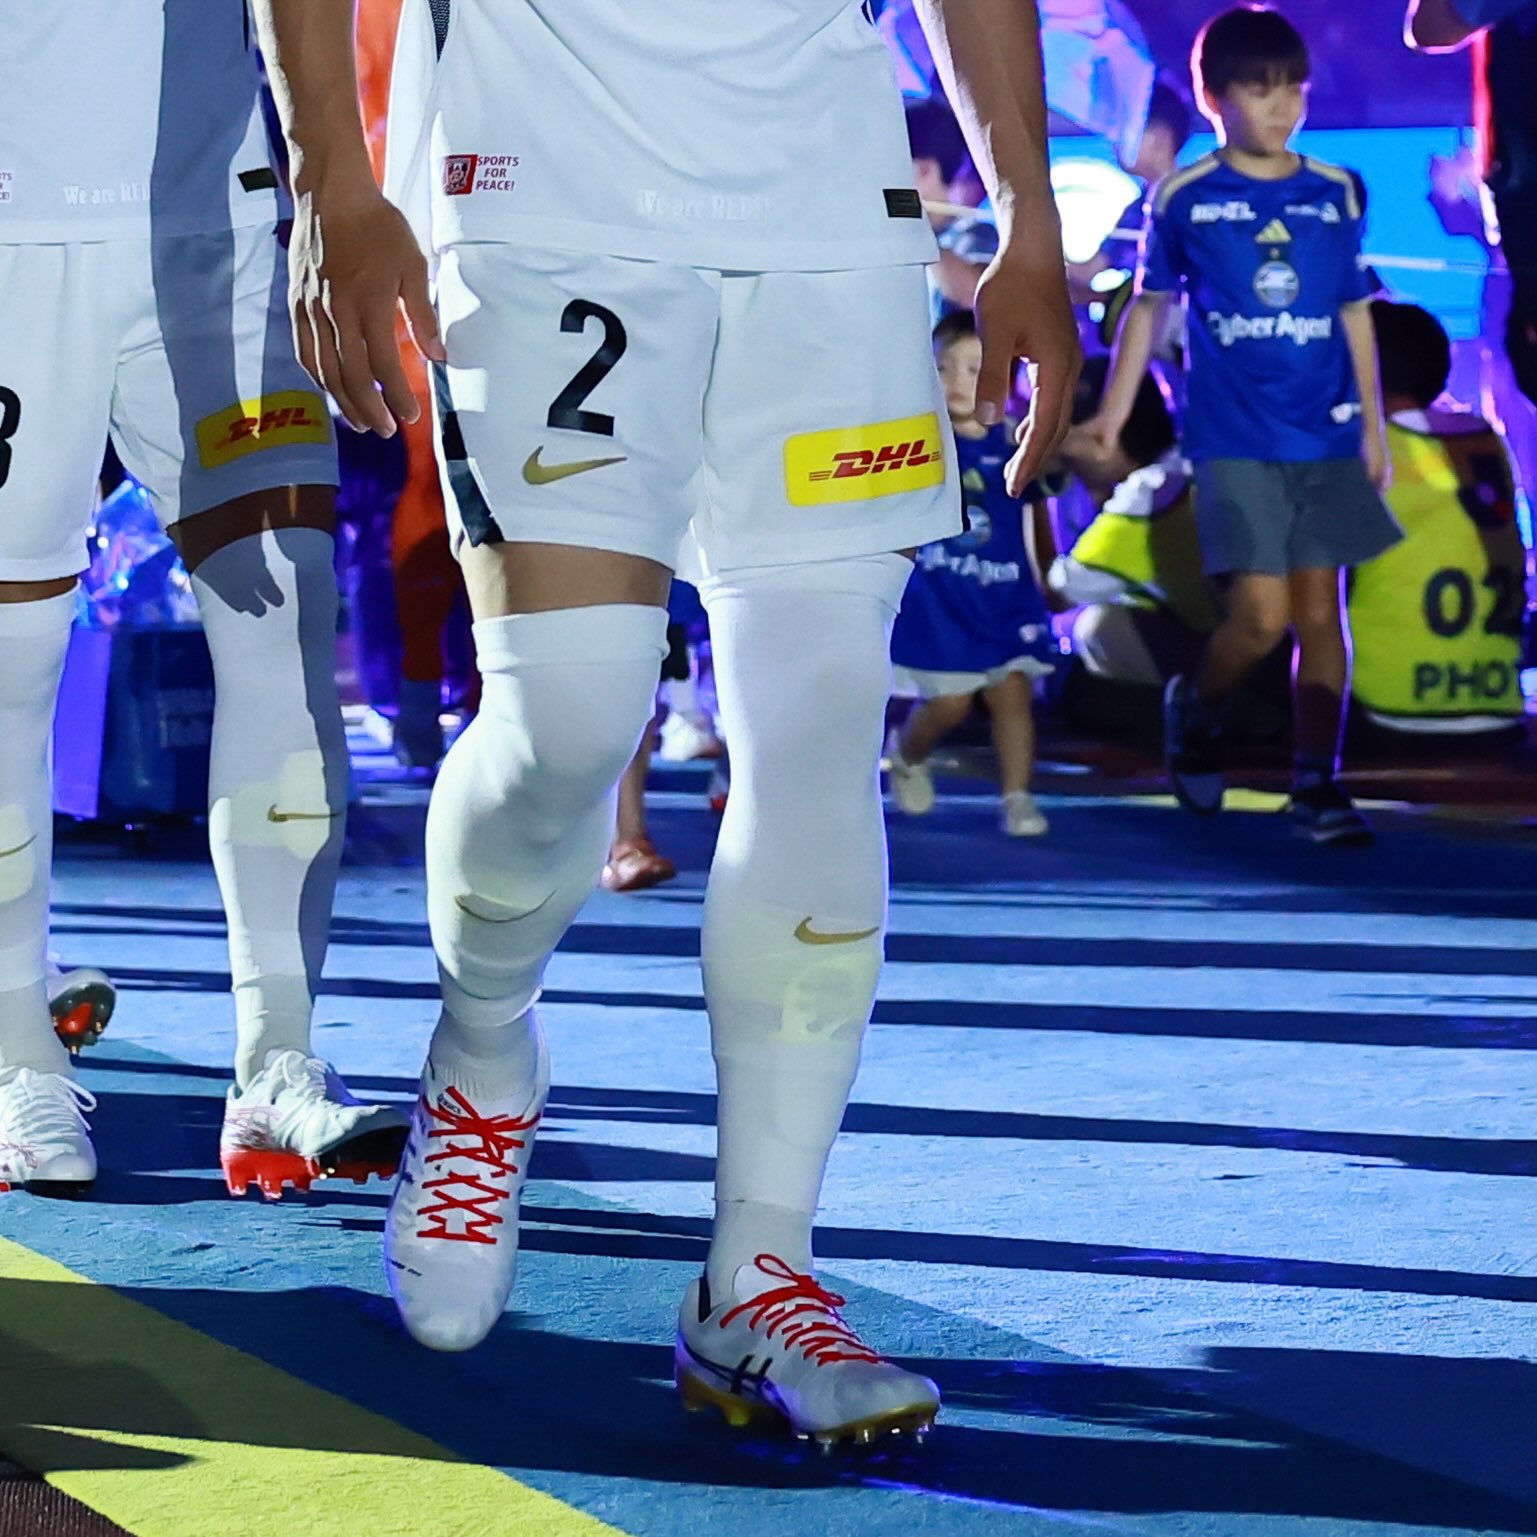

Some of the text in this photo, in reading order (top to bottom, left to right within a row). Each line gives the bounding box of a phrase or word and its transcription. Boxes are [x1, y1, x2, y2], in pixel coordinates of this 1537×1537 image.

[477, 156, 519, 167] SPORTS
[484, 168, 507, 178] FOR
[476, 180, 515, 192] PEACE!
[546, 298, 628, 437] 2
[832, 439, 931, 479] DHL
[1414, 660, 1510, 699] PHO
